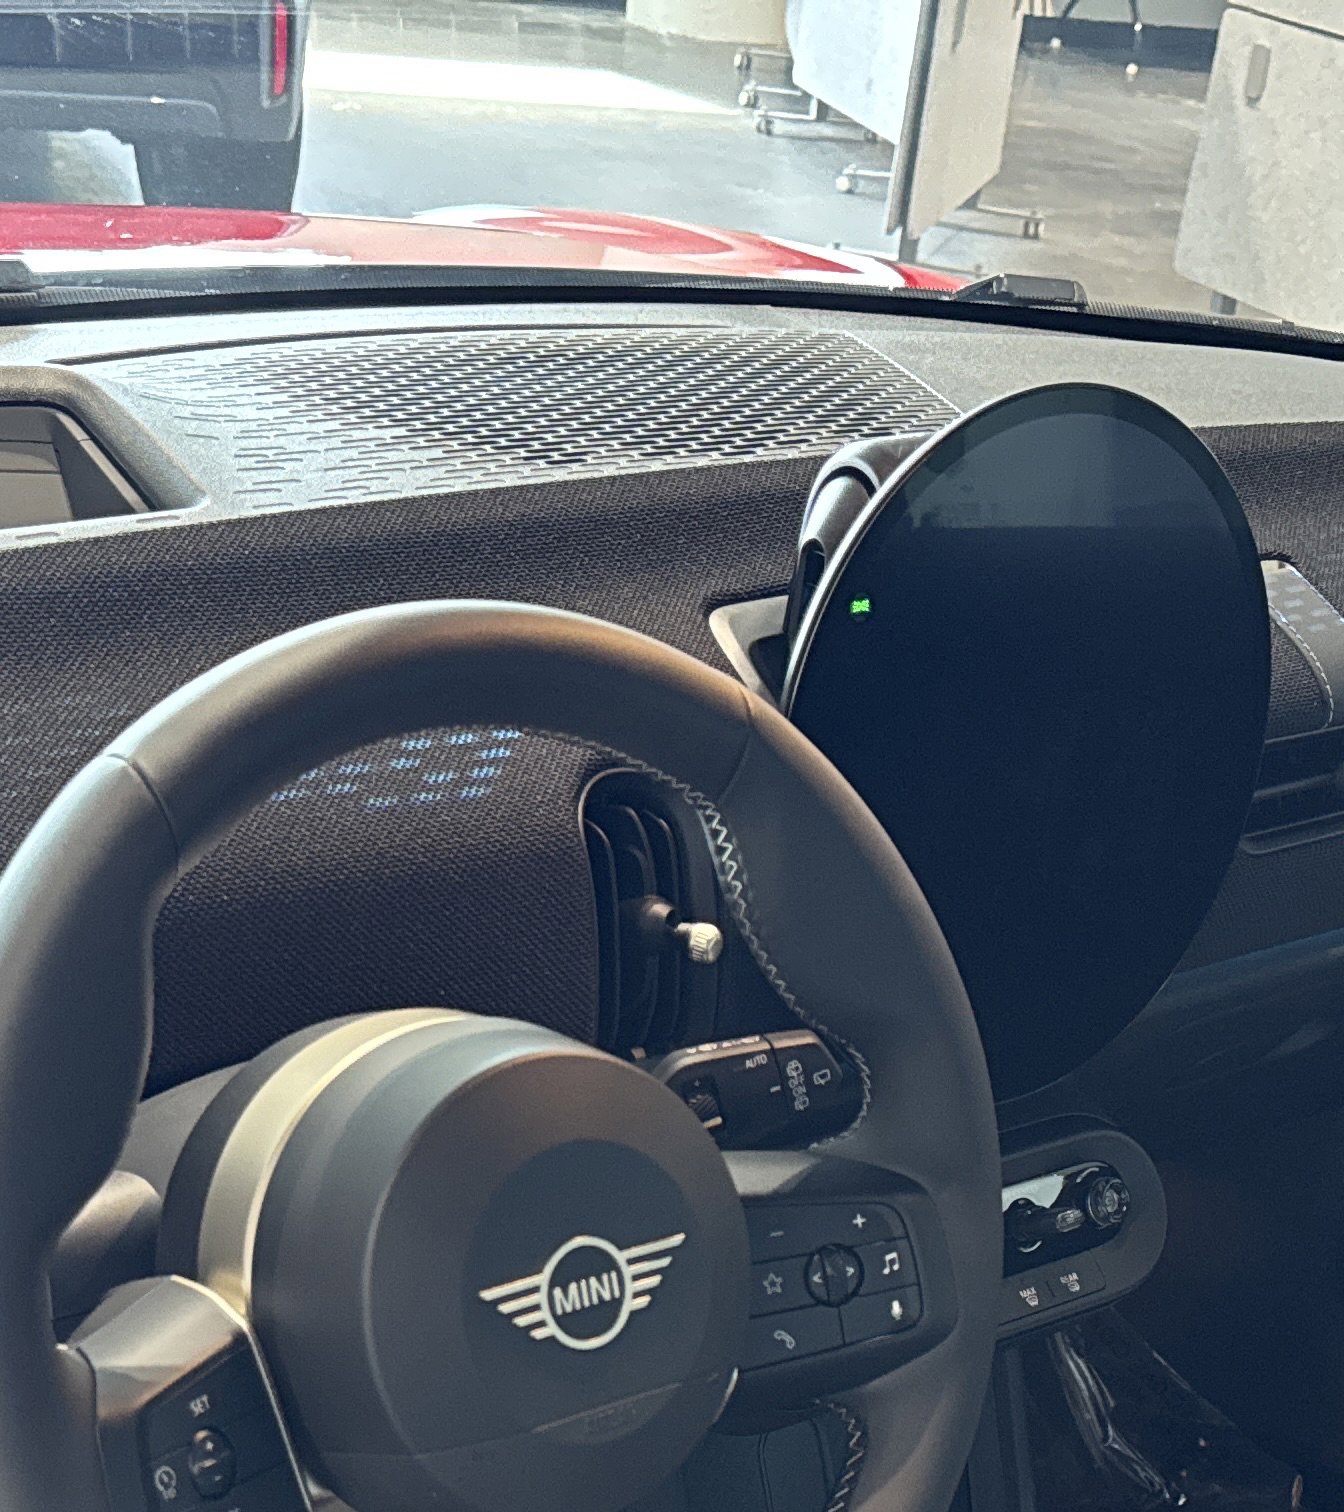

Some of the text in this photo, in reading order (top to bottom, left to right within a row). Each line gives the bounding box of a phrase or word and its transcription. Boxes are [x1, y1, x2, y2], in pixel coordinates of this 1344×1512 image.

[745, 1053, 769, 1070] AUTO
[551, 1269, 621, 1316] MINI
[188, 1393, 212, 1418] SET
